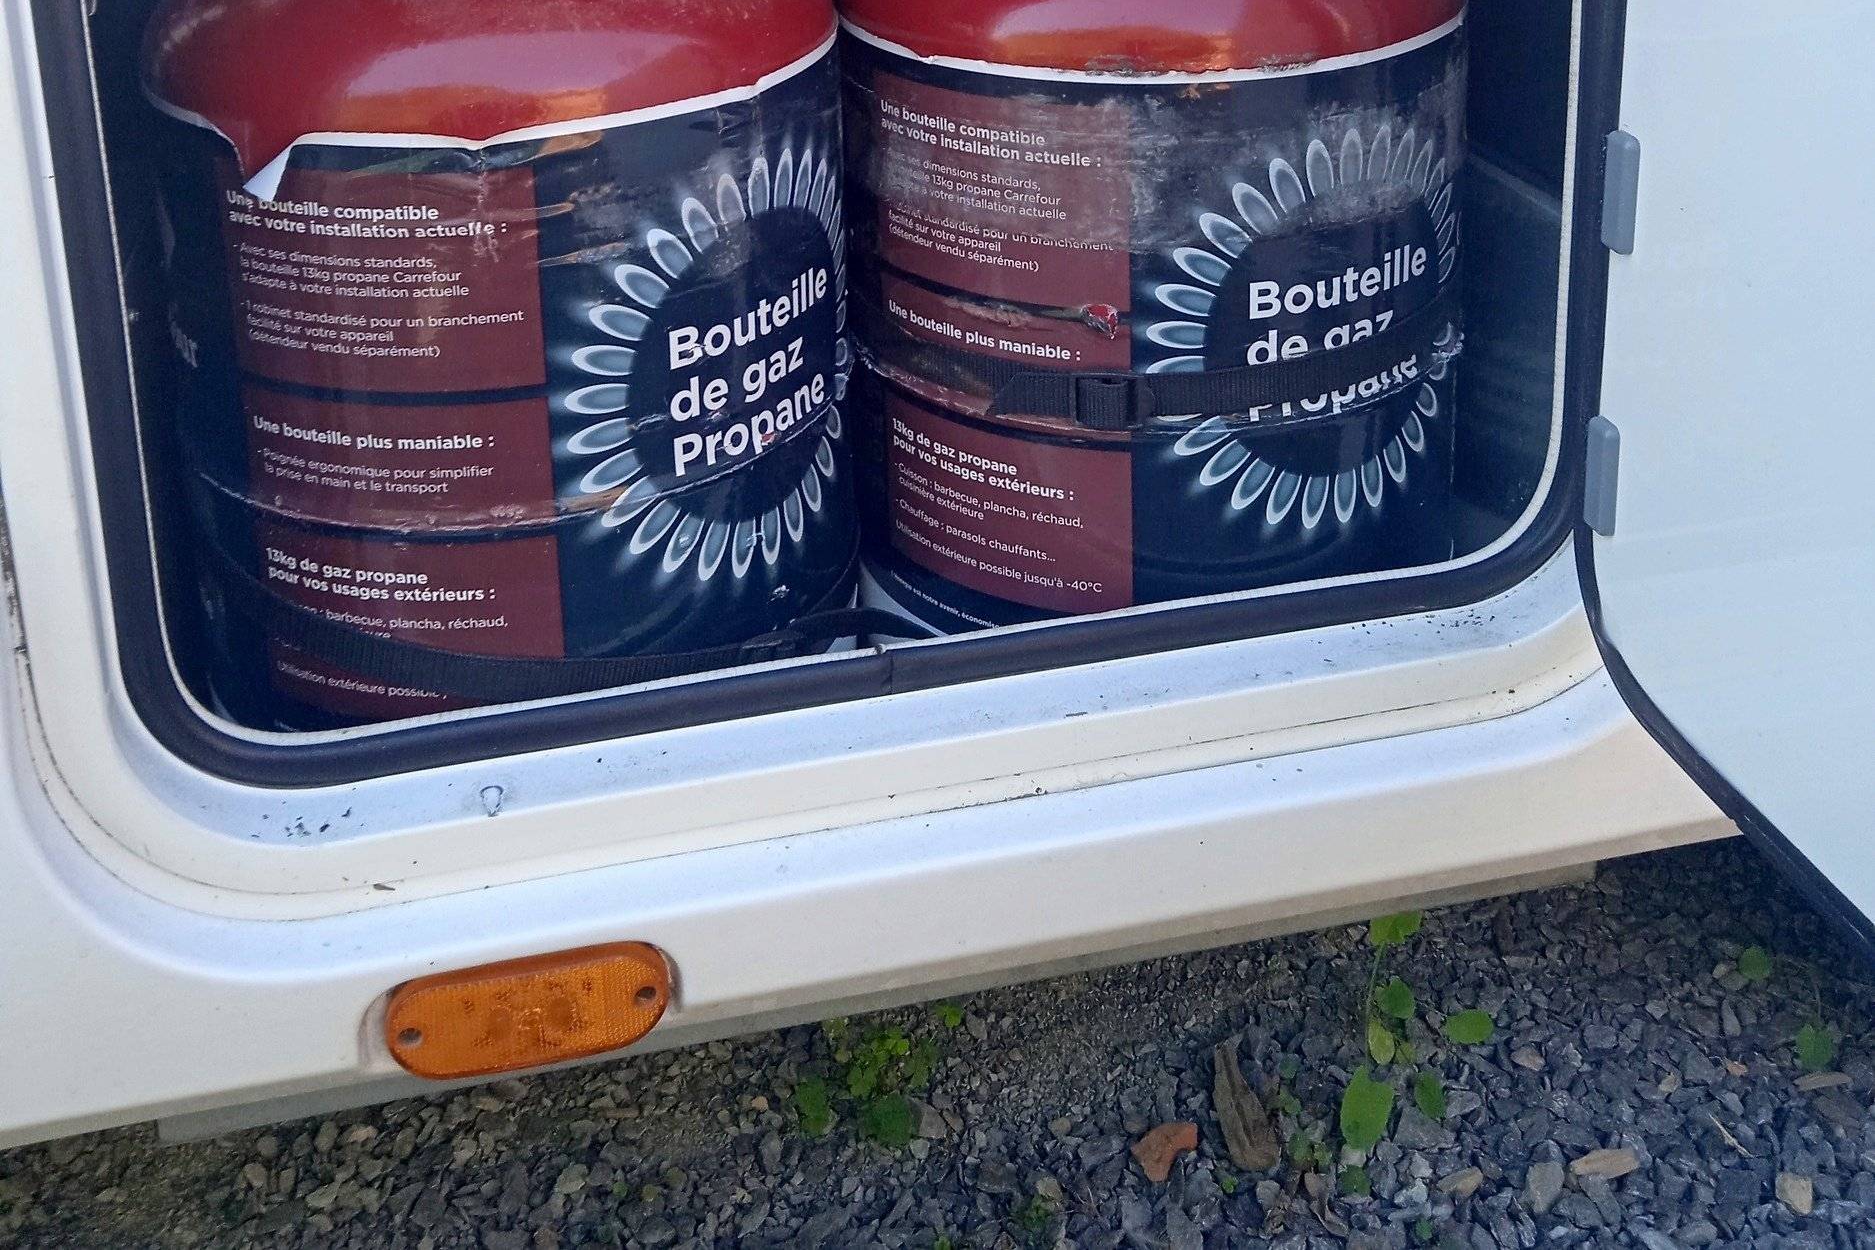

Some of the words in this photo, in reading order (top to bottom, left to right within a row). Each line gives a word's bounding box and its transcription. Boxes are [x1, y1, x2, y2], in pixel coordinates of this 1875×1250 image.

[881, 99, 900, 118] Une
[902, 105, 956, 133] bouteille
[959, 123, 1046, 147] compatible
[881, 116, 904, 134] avec
[906, 126, 937, 145] votre
[940, 134, 1020, 161] installation
[1024, 150, 1091, 167] actuelle
[923, 159, 978, 181] dimensions
[981, 173, 1041, 191] standards,
[931, 174, 954, 190] 13kg
[956, 181, 1001, 199] propane
[1003, 189, 1061, 206] Carrefour
[226, 189, 254, 207] Une
[259, 199, 329, 217] bouteille
[333, 205, 440, 222] compatible
[1018, 206, 1067, 220] actuelle
[229, 211, 262, 226] avec
[264, 217, 306, 233] votre
[309, 220, 410, 239] installation
[414, 221, 495, 238] actuelle
[915, 223, 930, 234] sur
[931, 226, 956, 242] votre
[958, 235, 1001, 252] appareil
[1012, 233, 1028, 243] un
[289, 251, 361, 268] dimensions
[364, 256, 437, 269] standards,
[935, 241, 966, 258] vendu
[967, 249, 1039, 273] séparément)
[299, 283, 332, 295] votre
[335, 283, 409, 298] installation
[412, 284, 470, 298] actuelle
[301, 266, 331, 282] 13kg
[333, 271, 390, 284] propane
[393, 270, 462, 284] Carrefour
[1249, 244, 1427, 320] Bouteille
[283, 323, 302, 335] sur
[304, 327, 338, 339] votre
[340, 330, 394, 342] appareil
[293, 311, 367, 327] standardisé
[370, 317, 403, 329] pour
[406, 317, 424, 328] un
[428, 310, 525, 328] branchement
[668, 267, 827, 371] Bouteille
[889, 299, 908, 319] Une
[910, 309, 962, 339] bouteille
[965, 329, 995, 349] plus
[999, 337, 1071, 361] maniable
[310, 342, 350, 355] vendu
[352, 344, 441, 358] séparément)
[1246, 329, 1309, 366] de
[669, 375, 729, 422] de
[742, 336, 804, 403] gaz
[253, 415, 280, 434] Une
[282, 421, 352, 447] bouteille
[356, 434, 393, 454] plus
[397, 435, 483, 450] maniable
[673, 373, 825, 477] Propane
[892, 417, 914, 441] 13kg
[916, 432, 931, 448] de
[933, 441, 956, 459] gaz
[959, 450, 1018, 476] propane
[275, 466, 302, 482] prise
[304, 473, 319, 485] en
[321, 476, 351, 489] main
[353, 479, 367, 491] et
[369, 480, 382, 492] le
[385, 481, 449, 495] transport
[307, 459, 390, 480] ergonomique
[394, 468, 425, 480] pour
[429, 464, 494, 482] simplifier
[893, 434, 916, 456] pour
[918, 449, 938, 466] vos
[940, 459, 985, 483] usages
[988, 476, 1065, 501] extérieurs
[898, 462, 929, 486] Cuisson
[934, 481, 981, 508] barbecue,
[983, 500, 1029, 521] plancha,
[1032, 510, 1084, 529] réchaud,
[937, 495, 984, 520] extérieure
[899, 498, 940, 528] Chauffage
[945, 524, 986, 546] parasols
[988, 538, 1056, 562] chauffants...
[265, 547, 297, 569] 13kg
[300, 557, 319, 573] de
[322, 564, 351, 580] gaz
[355, 568, 428, 586] propane
[895, 519, 931, 548] Utilisation
[932, 540, 977, 567] extérieure
[979, 560, 1022, 581] possible
[1024, 571, 1064, 590] jusqu'à
[1066, 580, 1102, 593] -40°C
[268, 566, 300, 585] pour
[303, 578, 329, 592] vos
[332, 583, 390, 601] usages
[393, 587, 485, 602] extérieurs
[326, 609, 386, 628] barbecue,
[389, 617, 446, 631] plancha,
[448, 615, 509, 631] réchaud,
[327, 676, 385, 695] extérieure
